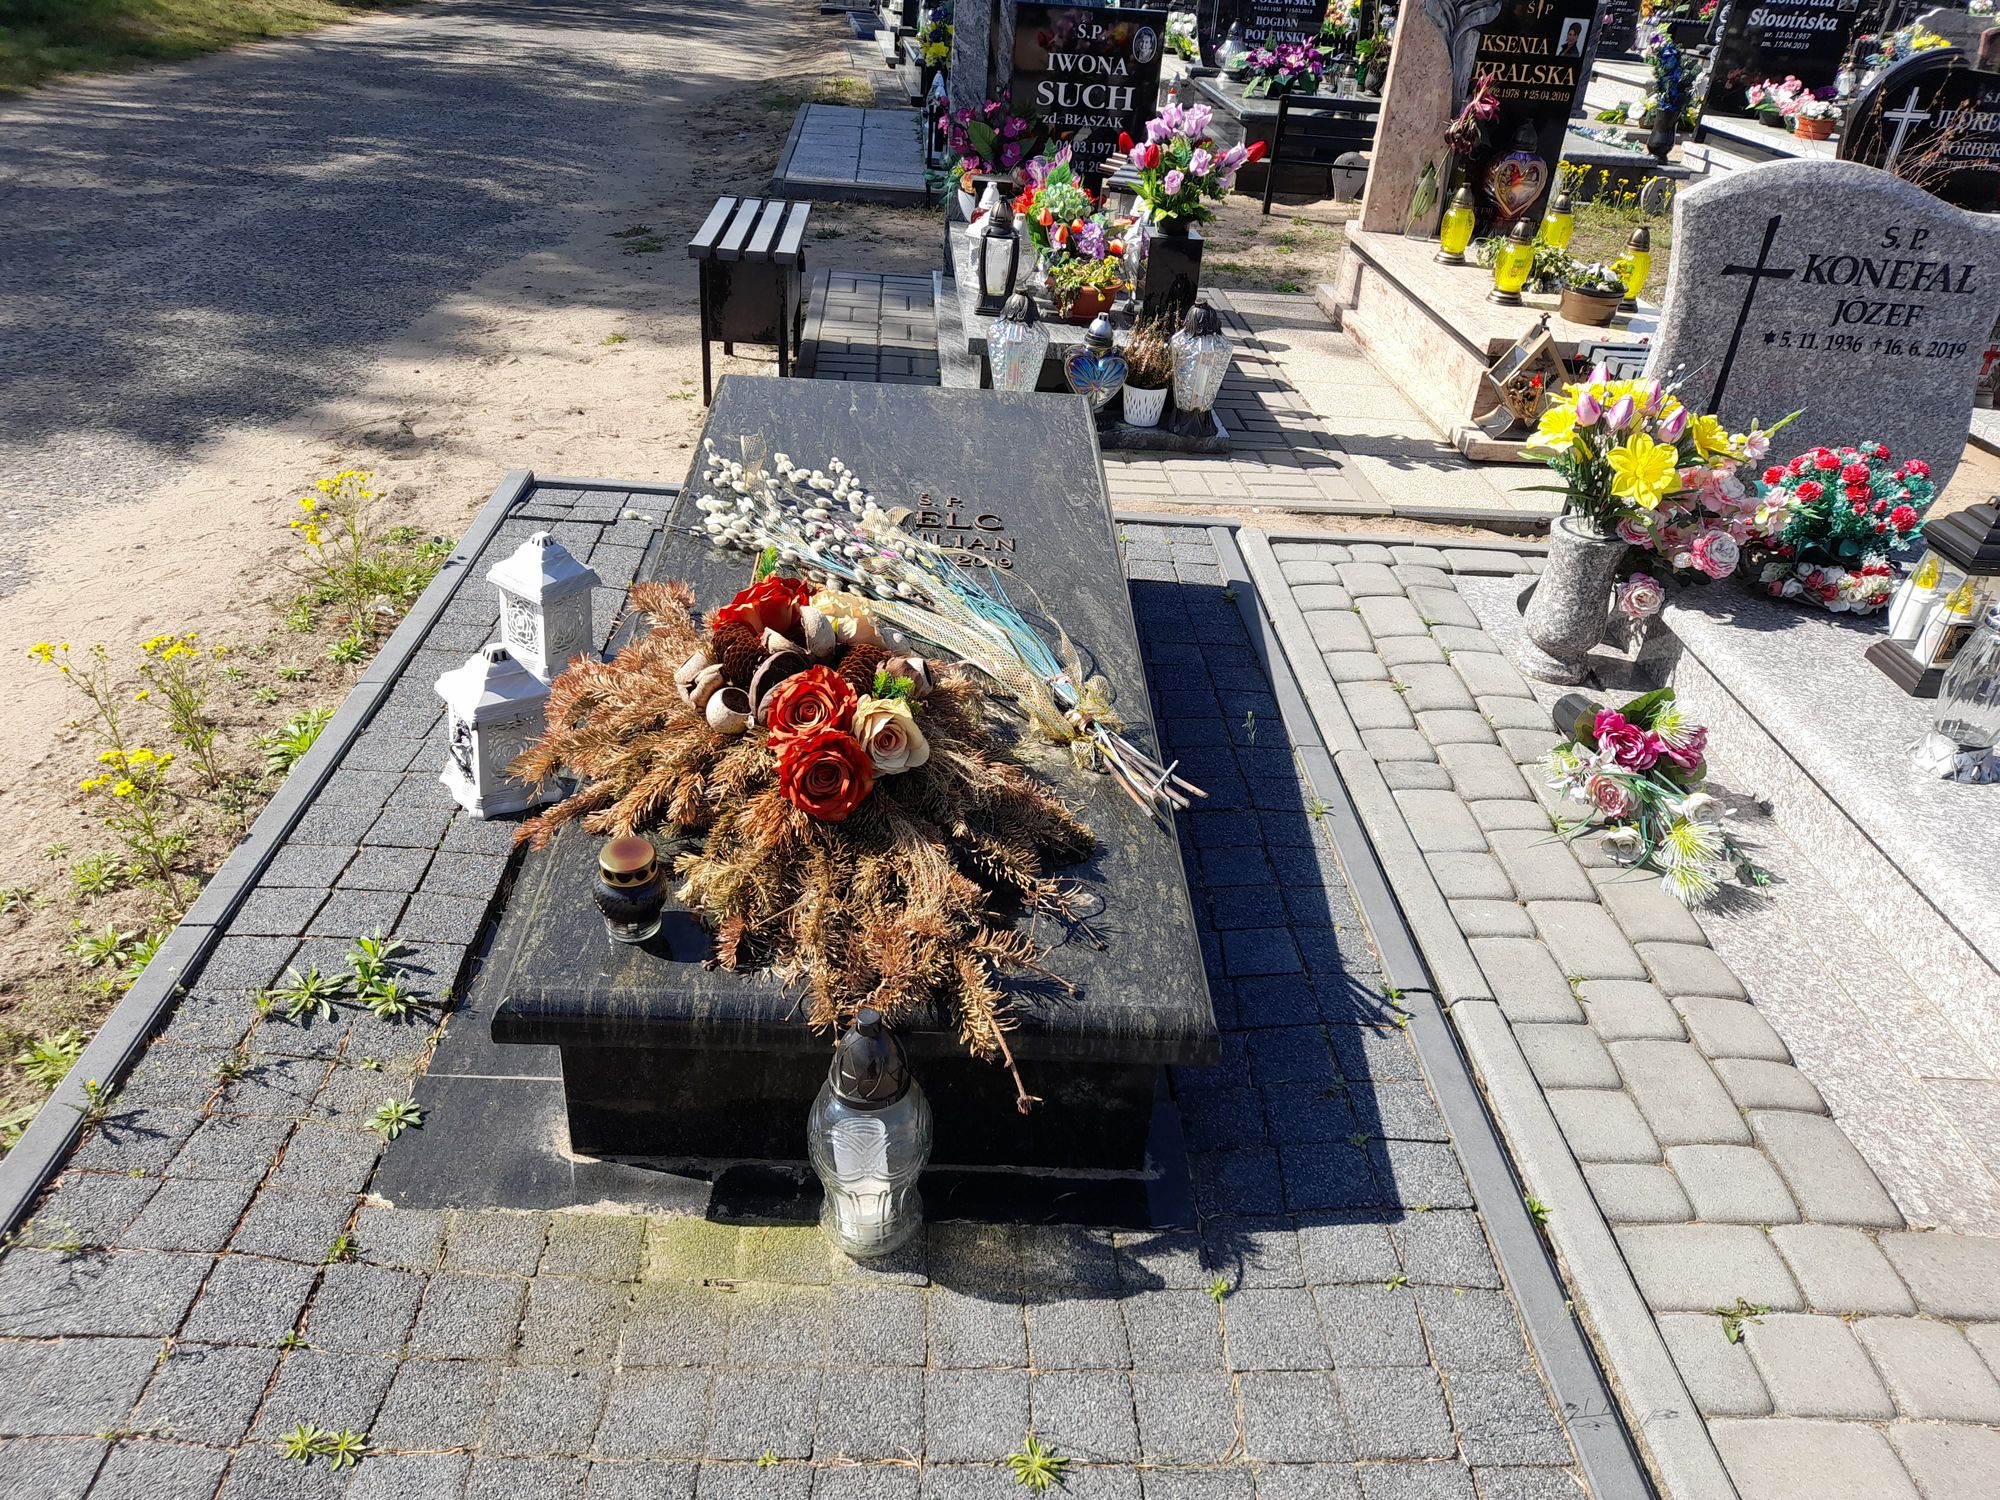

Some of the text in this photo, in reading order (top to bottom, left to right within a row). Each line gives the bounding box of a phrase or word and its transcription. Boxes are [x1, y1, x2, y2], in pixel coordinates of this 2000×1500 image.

[1076, 19, 1106, 40] Ś.P.
[1255, 15, 1299, 28] BOGDAN
[1747, 8, 1839, 31] Słowińska
[1480, 34, 1550, 56] KSENIA
[1773, 40, 1811, 50] 17.04.2019
[1046, 52, 1129, 76] IWONA
[1471, 61, 1576, 86] KRALSKA
[1036, 80, 1136, 111] SUCH
[1064, 113, 1124, 129] BŁASZAK
[1941, 140, 2000, 158] ORBER
[1800, 253, 1978, 294] KONEFAŁ
[1828, 296, 1925, 328] JÓZEF
[1824, 334, 1864, 353] 1936
[1925, 340, 1968, 359] 2019
